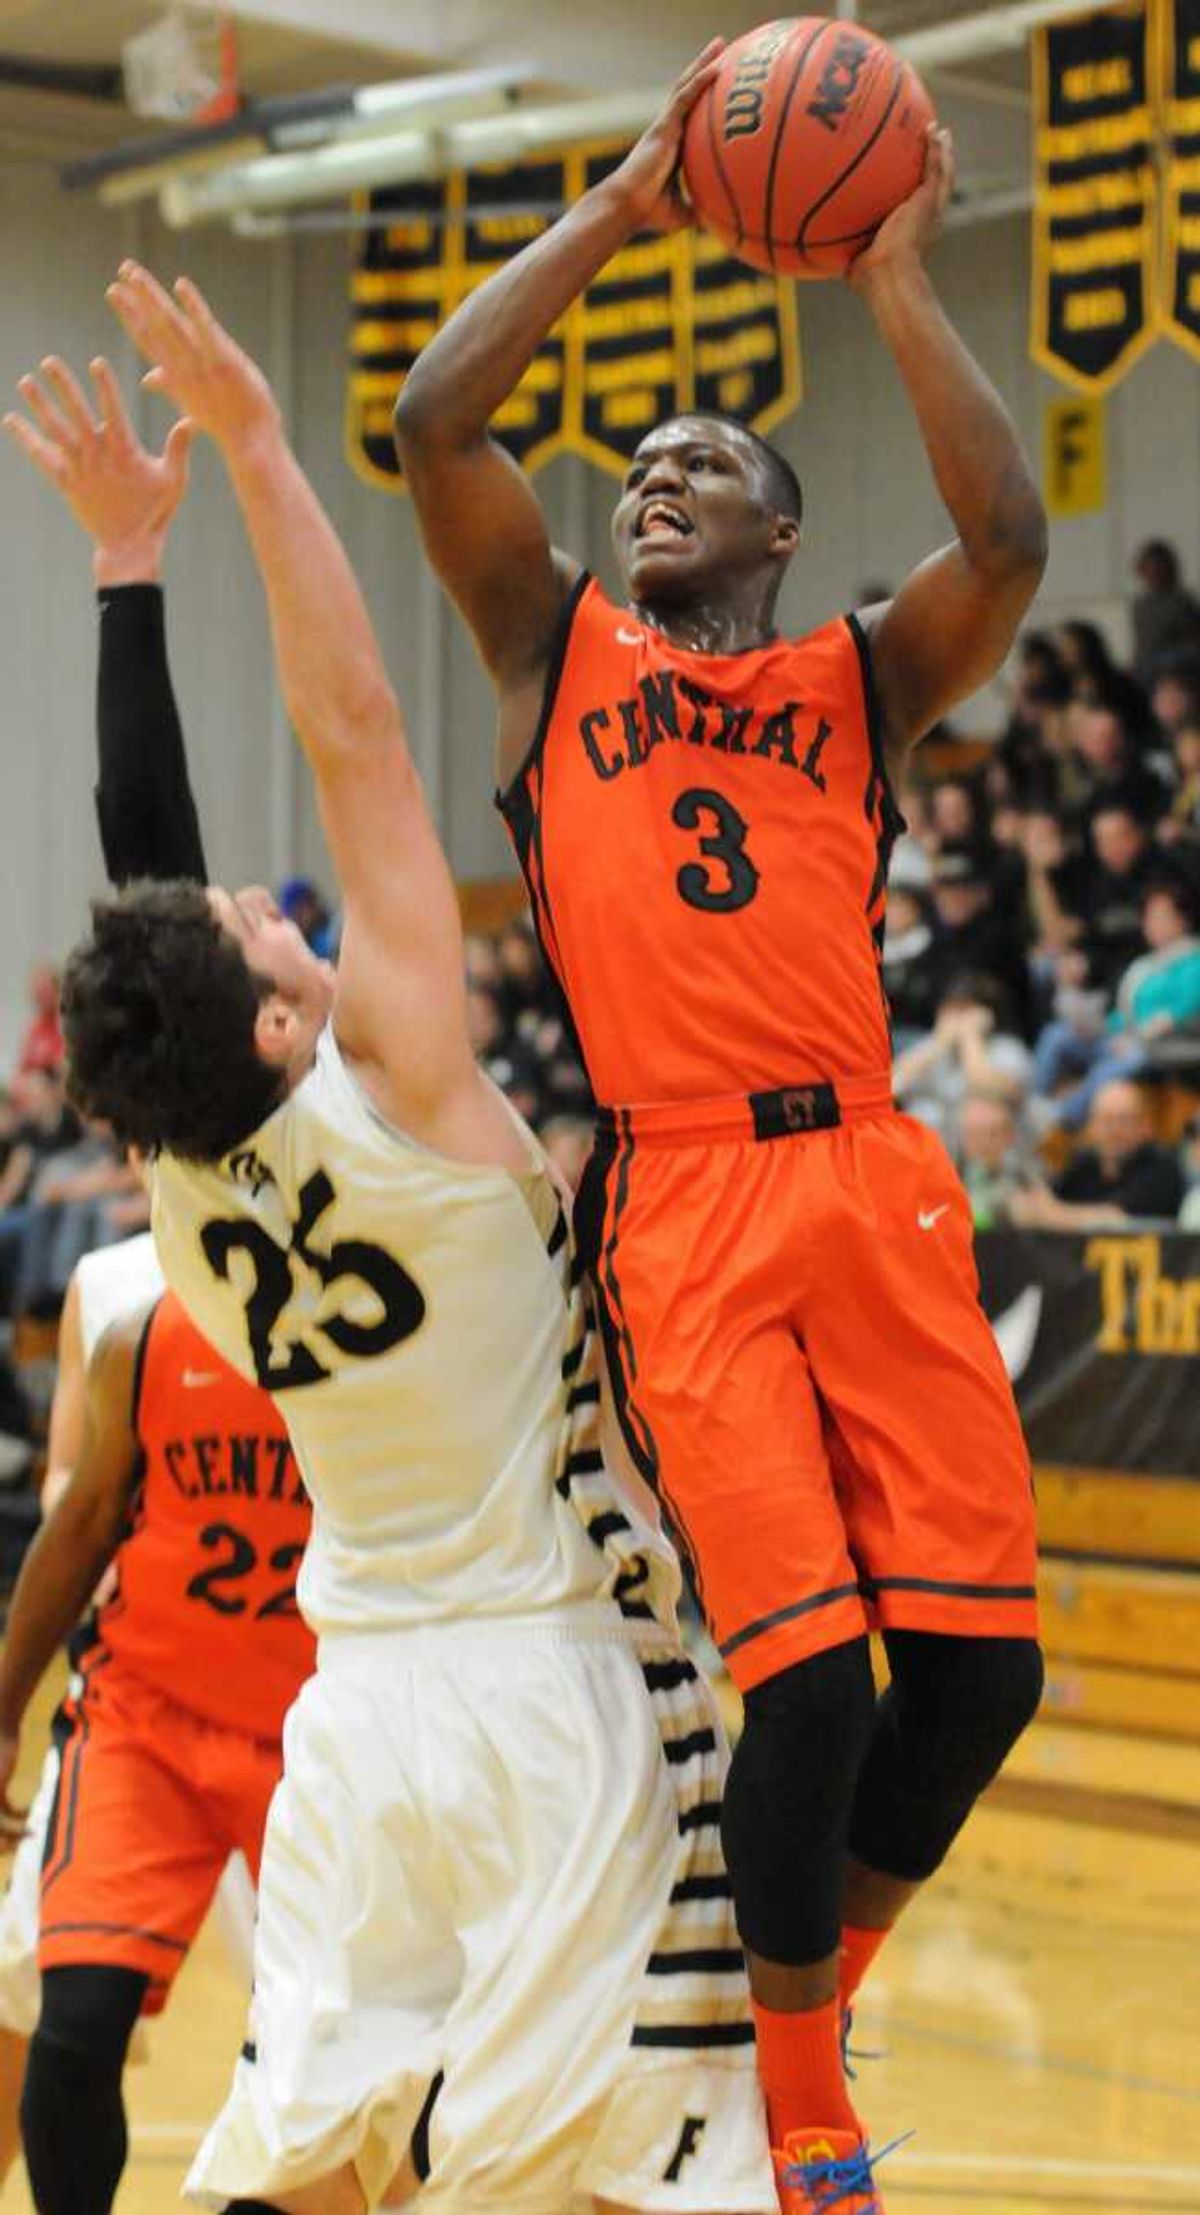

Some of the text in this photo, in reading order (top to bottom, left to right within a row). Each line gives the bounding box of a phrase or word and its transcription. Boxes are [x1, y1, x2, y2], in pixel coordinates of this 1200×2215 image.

[579, 669, 832, 795] CENTRAL
[672, 787, 760, 913] 3
[200, 1168, 426, 1391] 25
[662, 2116, 706, 2183] F
